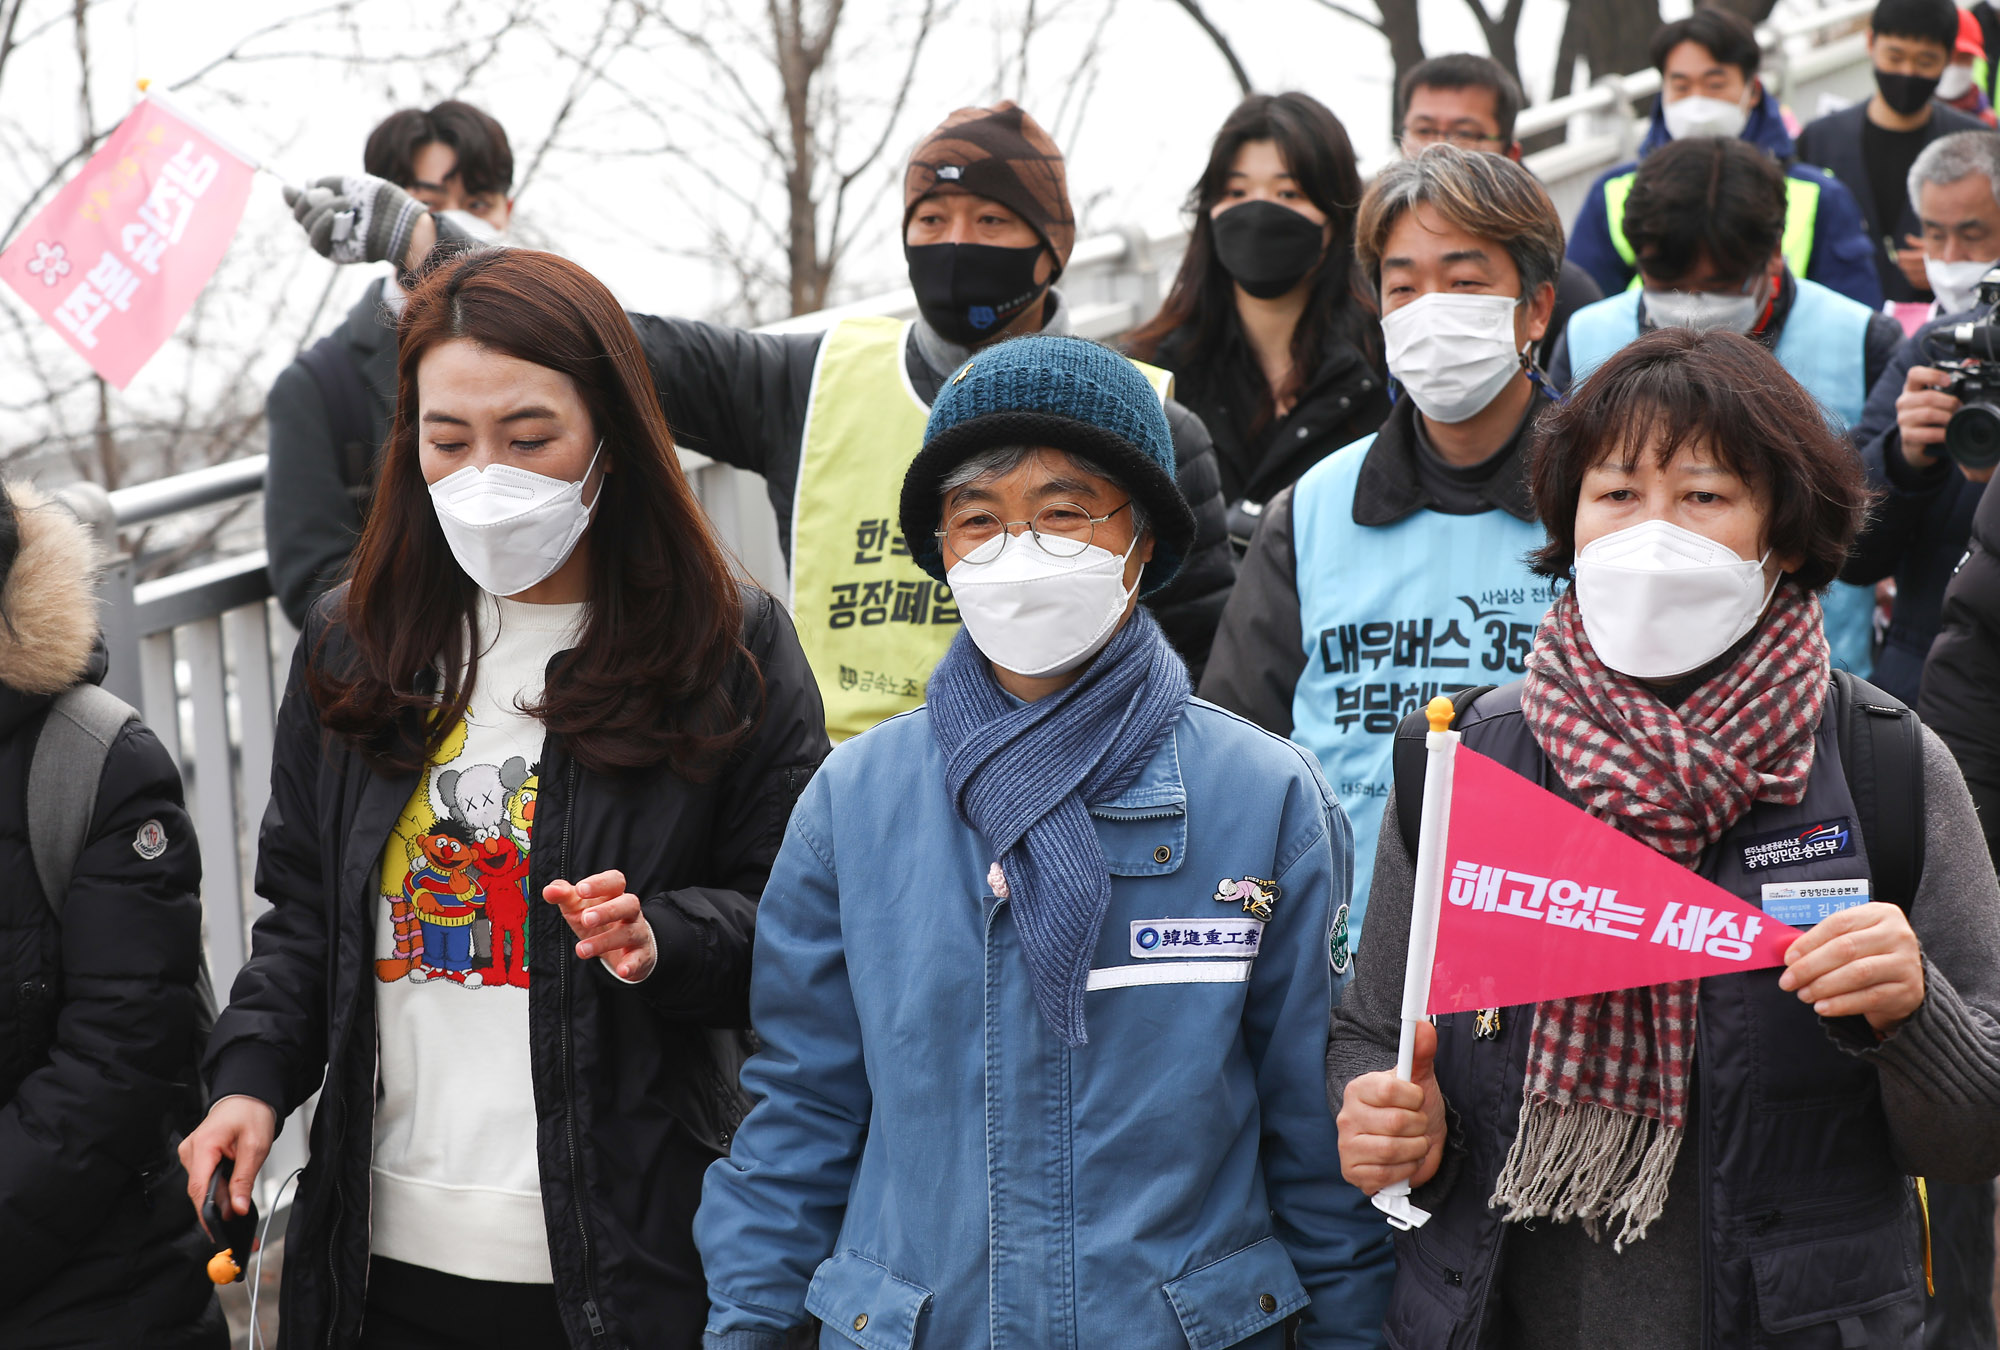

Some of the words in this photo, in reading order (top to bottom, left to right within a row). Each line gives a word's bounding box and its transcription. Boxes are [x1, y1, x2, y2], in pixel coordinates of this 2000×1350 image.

[1480, 587, 1525, 605] 사실상
[1320, 618, 1470, 674] 대우버스
[1481, 619, 1538, 674] 35
[859, 670, 918, 697] 금속노조
[1334, 681, 1478, 734] 부당해
[1745, 840, 1838, 868] 공항항만운송본부
[1800, 887, 1859, 897] 공항항만운송본부
[1447, 860, 1646, 940] 해고없는
[1649, 902, 1763, 961] 세상
[1161, 929, 1259, 947] 韓進重工業
